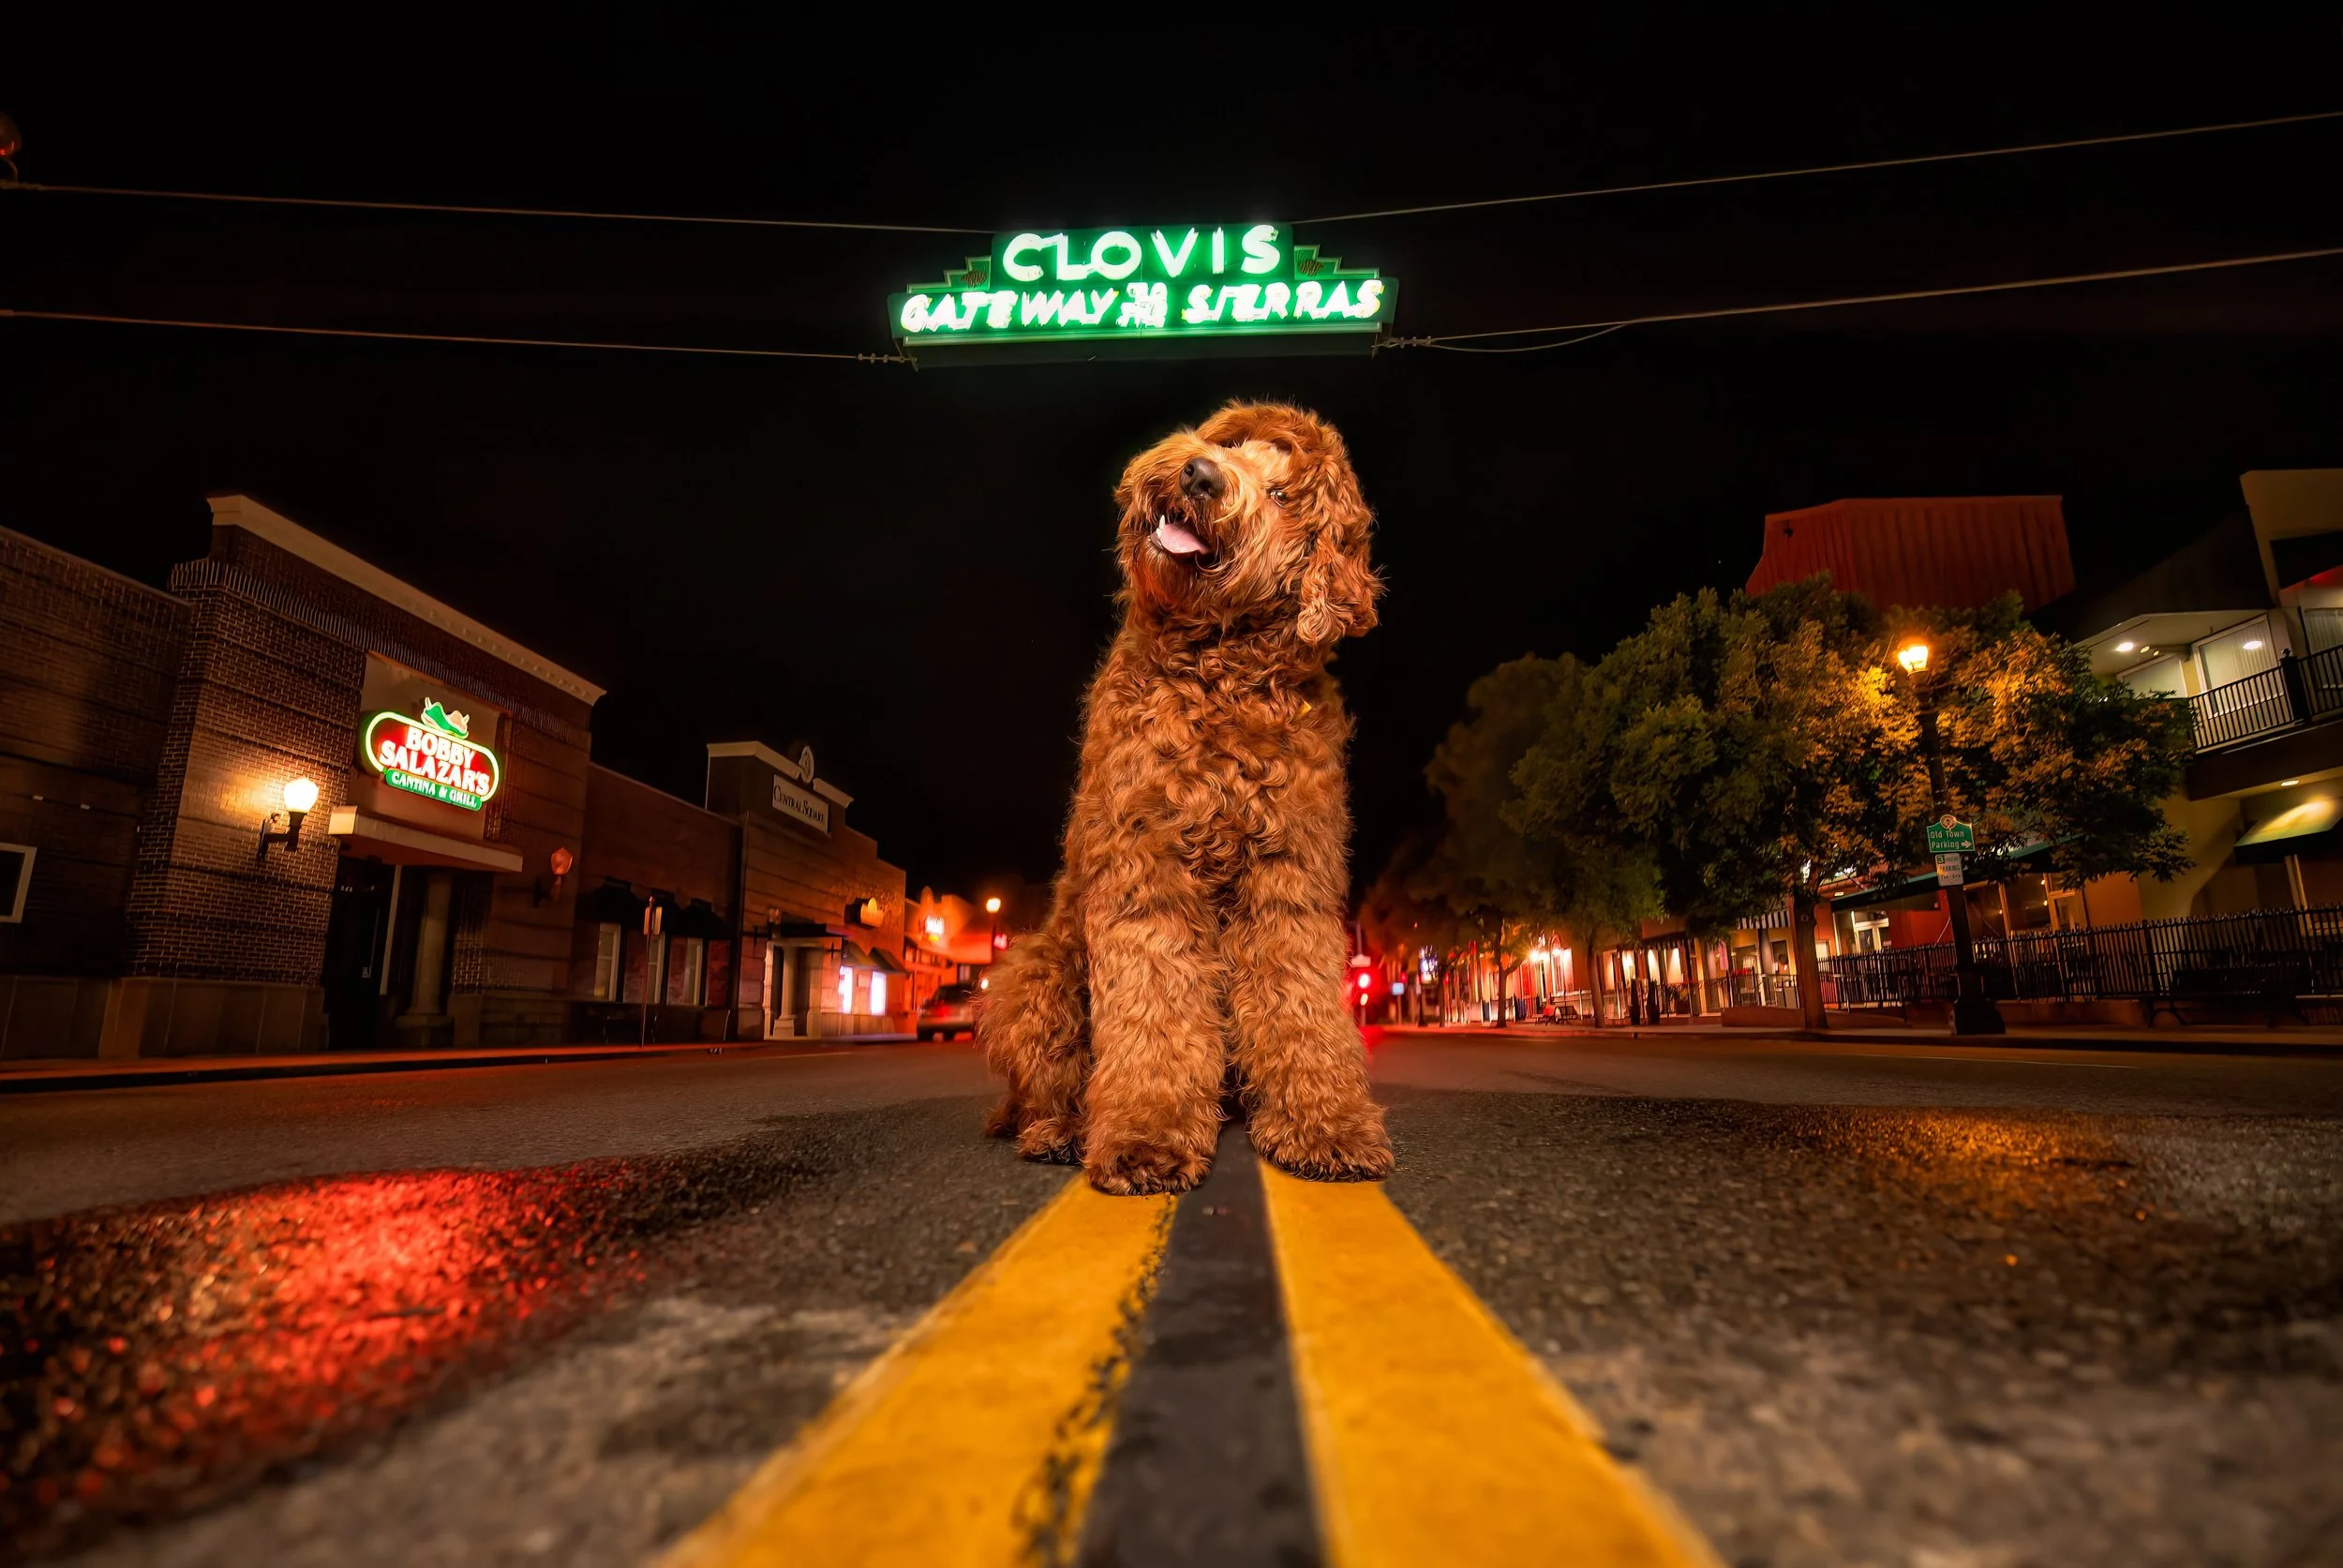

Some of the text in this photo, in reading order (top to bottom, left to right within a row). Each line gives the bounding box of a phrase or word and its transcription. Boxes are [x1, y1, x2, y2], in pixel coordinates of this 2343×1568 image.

[1003, 224, 1281, 281] CLOVIS
[901, 288, 1118, 333] GATEWAY
[1181, 280, 1384, 323] SIERRAS
[379, 740, 490, 797] SALAZAR'S
[406, 726, 475, 769] BOBBY
[391, 771, 477, 808] CANTINA & GRILL
[1932, 841, 1960, 849] Parking
